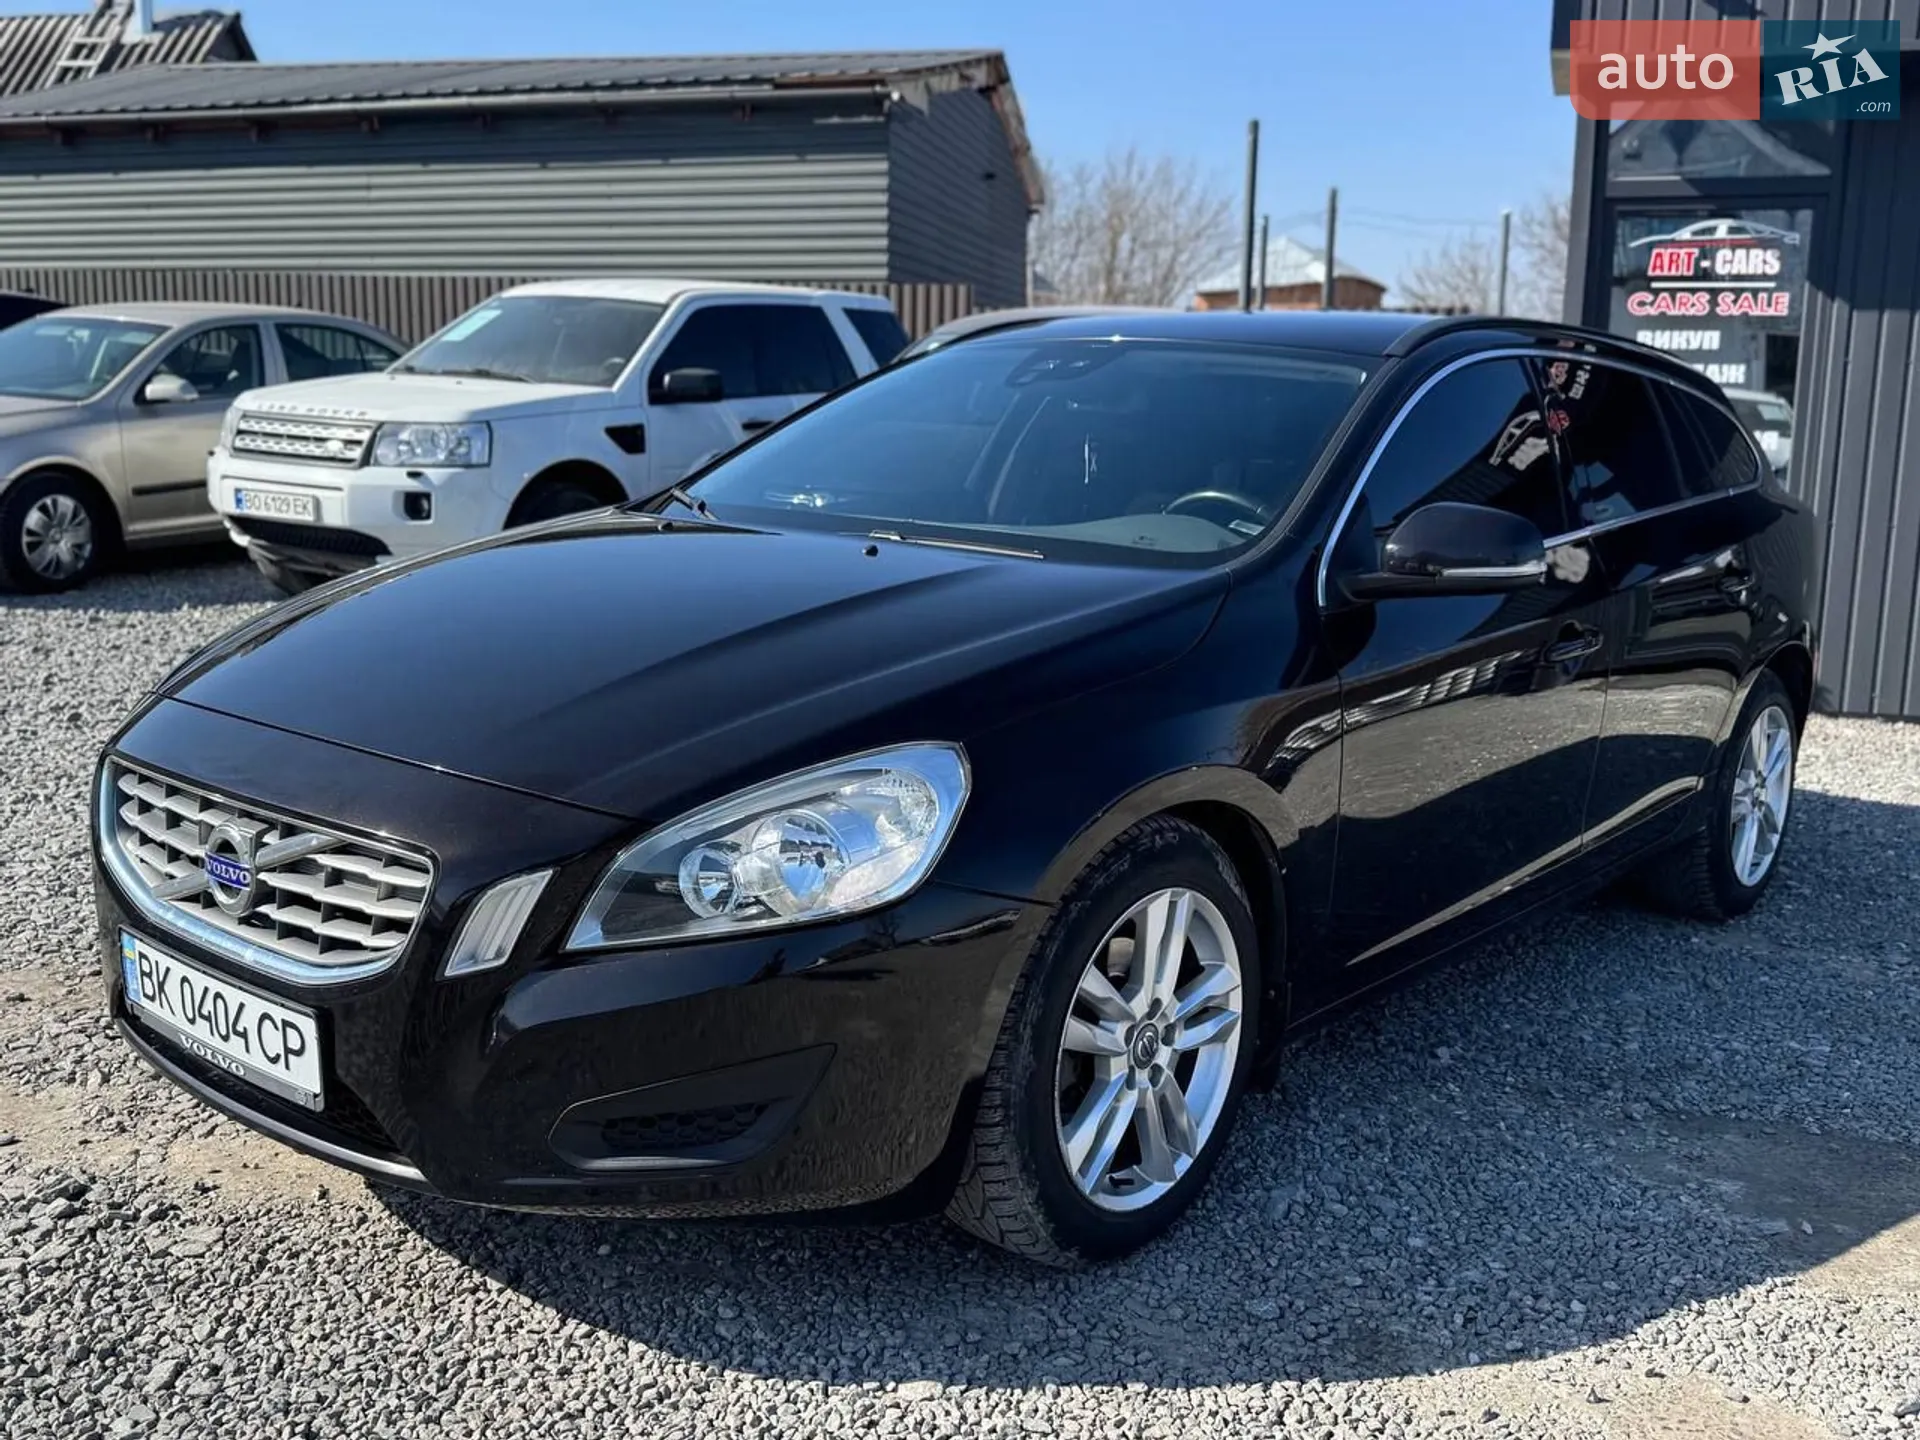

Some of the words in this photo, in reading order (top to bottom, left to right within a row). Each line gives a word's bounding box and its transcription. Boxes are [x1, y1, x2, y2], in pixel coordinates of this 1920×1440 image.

[1648, 248, 1699, 276] ART
[1715, 249, 1780, 275] CARS
[1627, 292, 1710, 316] CARS
[1716, 292, 1789, 316] SALE
[206, 859, 252, 884] VOLVO
[138, 950, 176, 1016] BK
[179, 975, 251, 1054] 0404
[257, 1012, 306, 1071] CP
[178, 1032, 246, 1077] VOLVO
